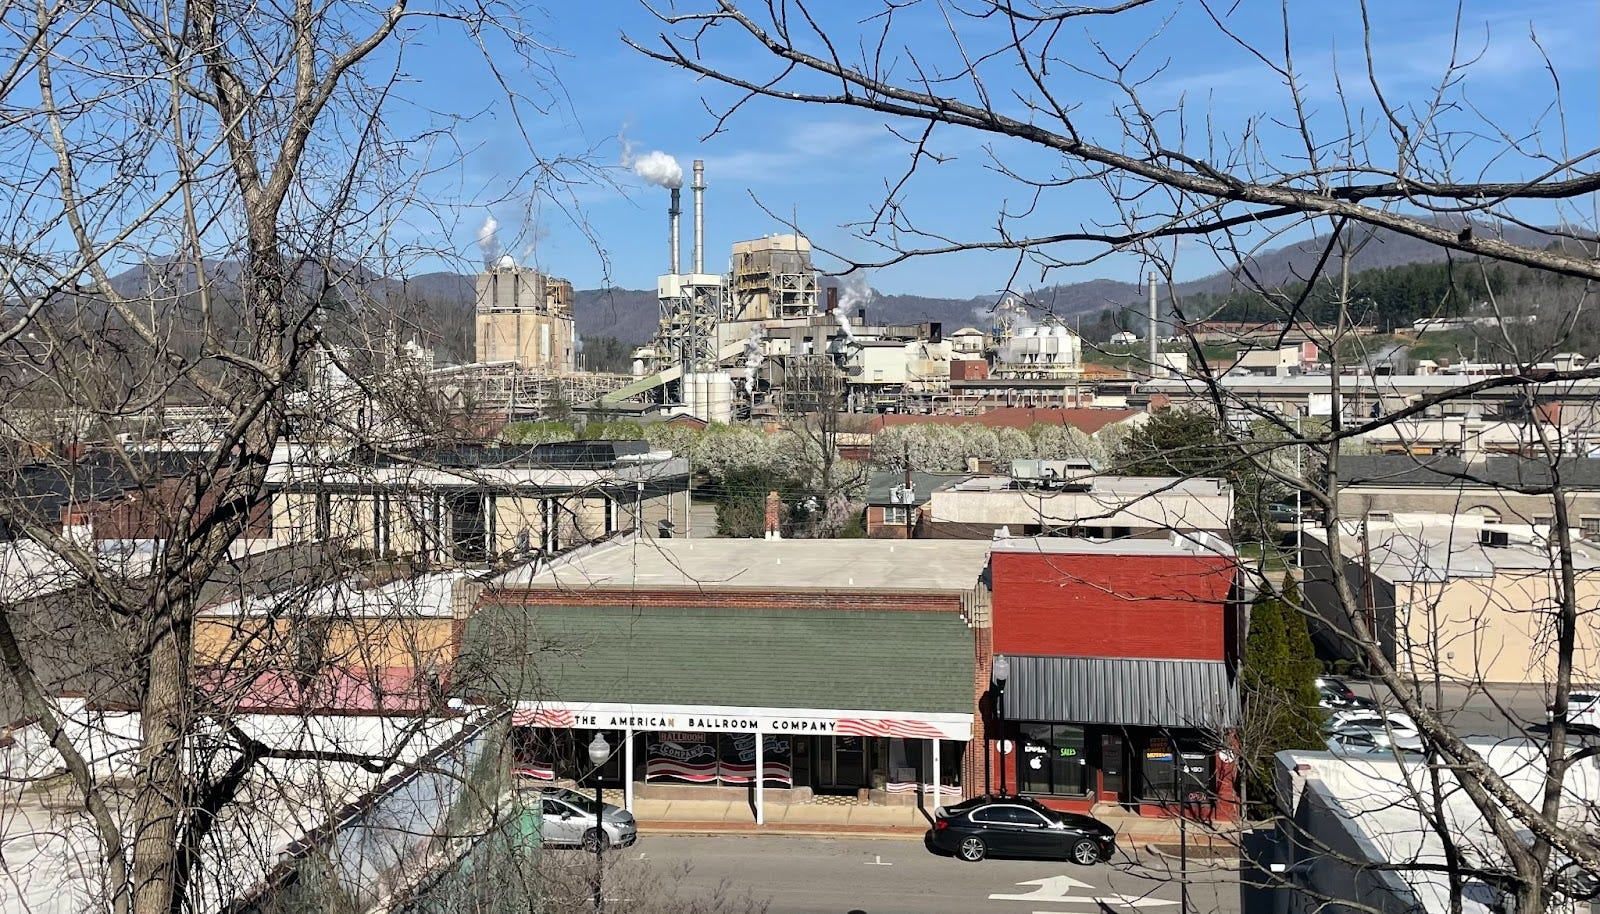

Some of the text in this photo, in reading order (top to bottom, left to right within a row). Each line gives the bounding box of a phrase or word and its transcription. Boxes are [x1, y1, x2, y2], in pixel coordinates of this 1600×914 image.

[575, 716, 836, 731] THE AMERICAN BALLROOM COMPANY
[660, 732, 704, 742] BALLROOM
[663, 745, 702, 759] COMPANY
